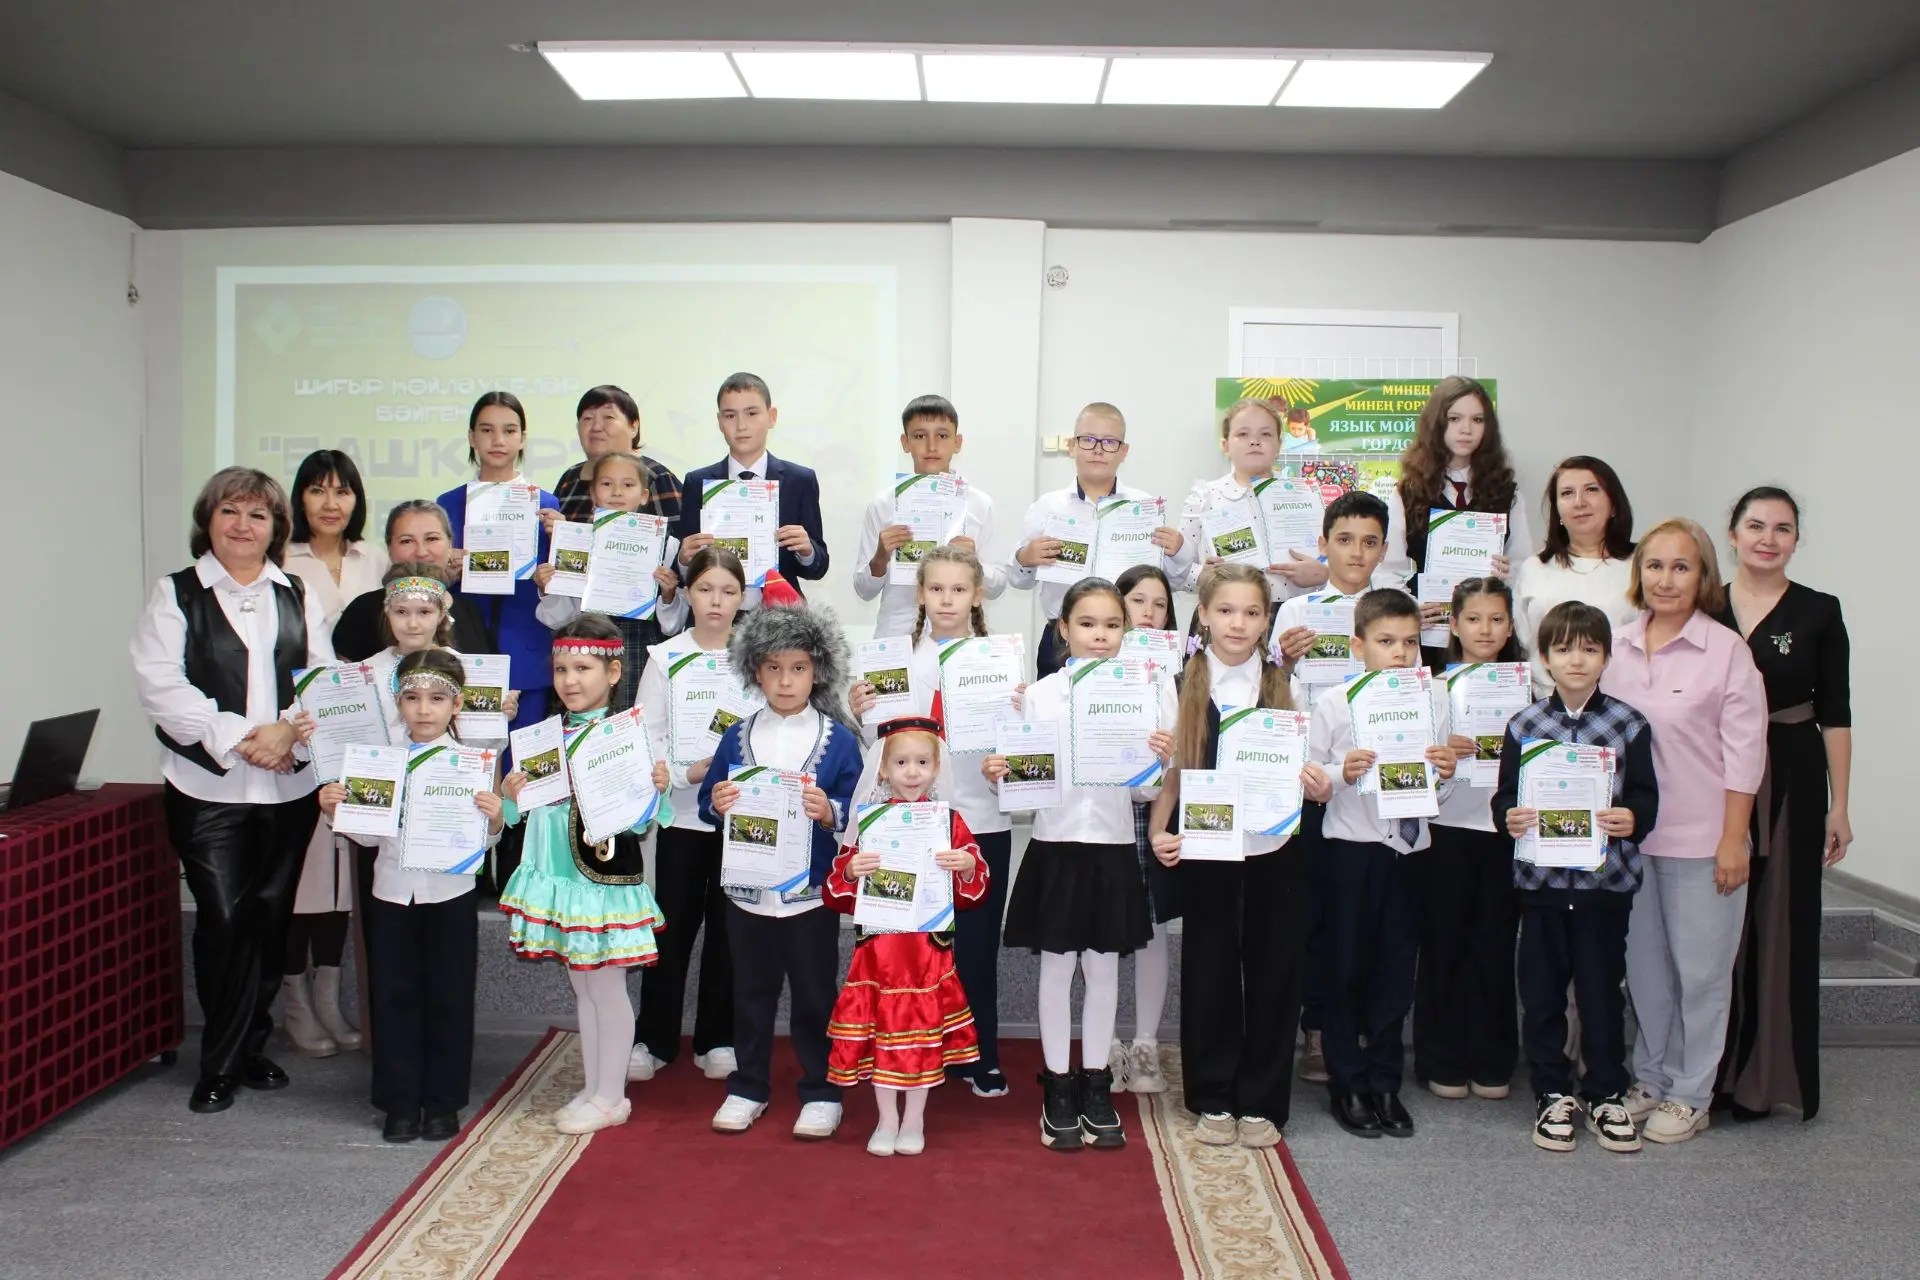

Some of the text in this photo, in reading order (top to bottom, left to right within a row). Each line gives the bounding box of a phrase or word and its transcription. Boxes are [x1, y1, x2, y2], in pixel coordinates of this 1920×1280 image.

[1346, 401, 1394, 413] МИНЕҢ
[1330, 418, 1416, 433] ЯЗЫК МОЙ
[1273, 501, 1312, 511] ДИПЛОМ
[1111, 531, 1153, 542] ДИПЛОМ
[605, 541, 648, 554] ДИПЛОМ
[1442, 546, 1487, 558] ДИПЛОМ
[959, 674, 1008, 687] ДИПЛОМ
[686, 691, 718, 701] ДИПЛ
[318, 703, 366, 718] ДИПЛОМ
[1088, 703, 1143, 715] ДИПЛОМ
[1368, 711, 1419, 724] ДИПЛОМ
[588, 742, 634, 770] ДИПЛОМ
[1236, 750, 1289, 764] ДИПЛОМ
[423, 785, 474, 797] ДИПЛОМ
